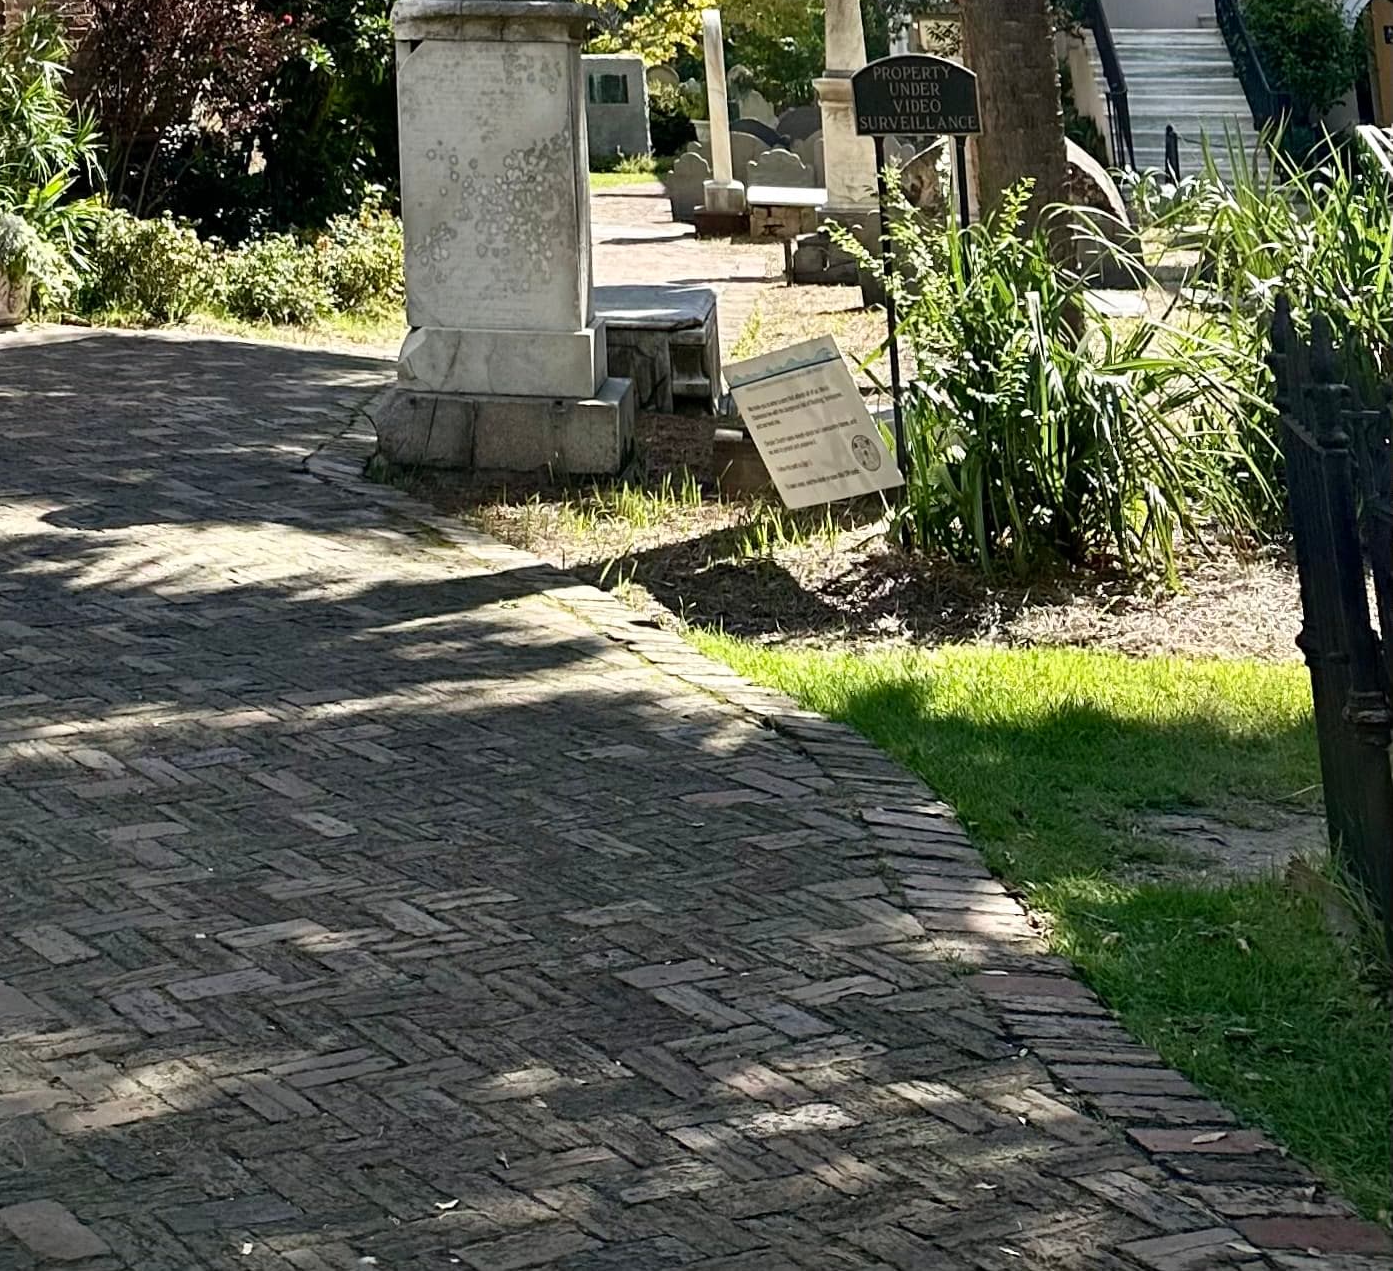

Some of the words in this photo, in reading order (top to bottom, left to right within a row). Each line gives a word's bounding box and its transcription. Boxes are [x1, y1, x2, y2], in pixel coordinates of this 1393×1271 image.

[872, 65, 952, 81] PROPERTY
[889, 82, 941, 96] UNDER
[893, 98, 942, 114] VIDEO
[859, 114, 978, 131] SURVEILLANCE
